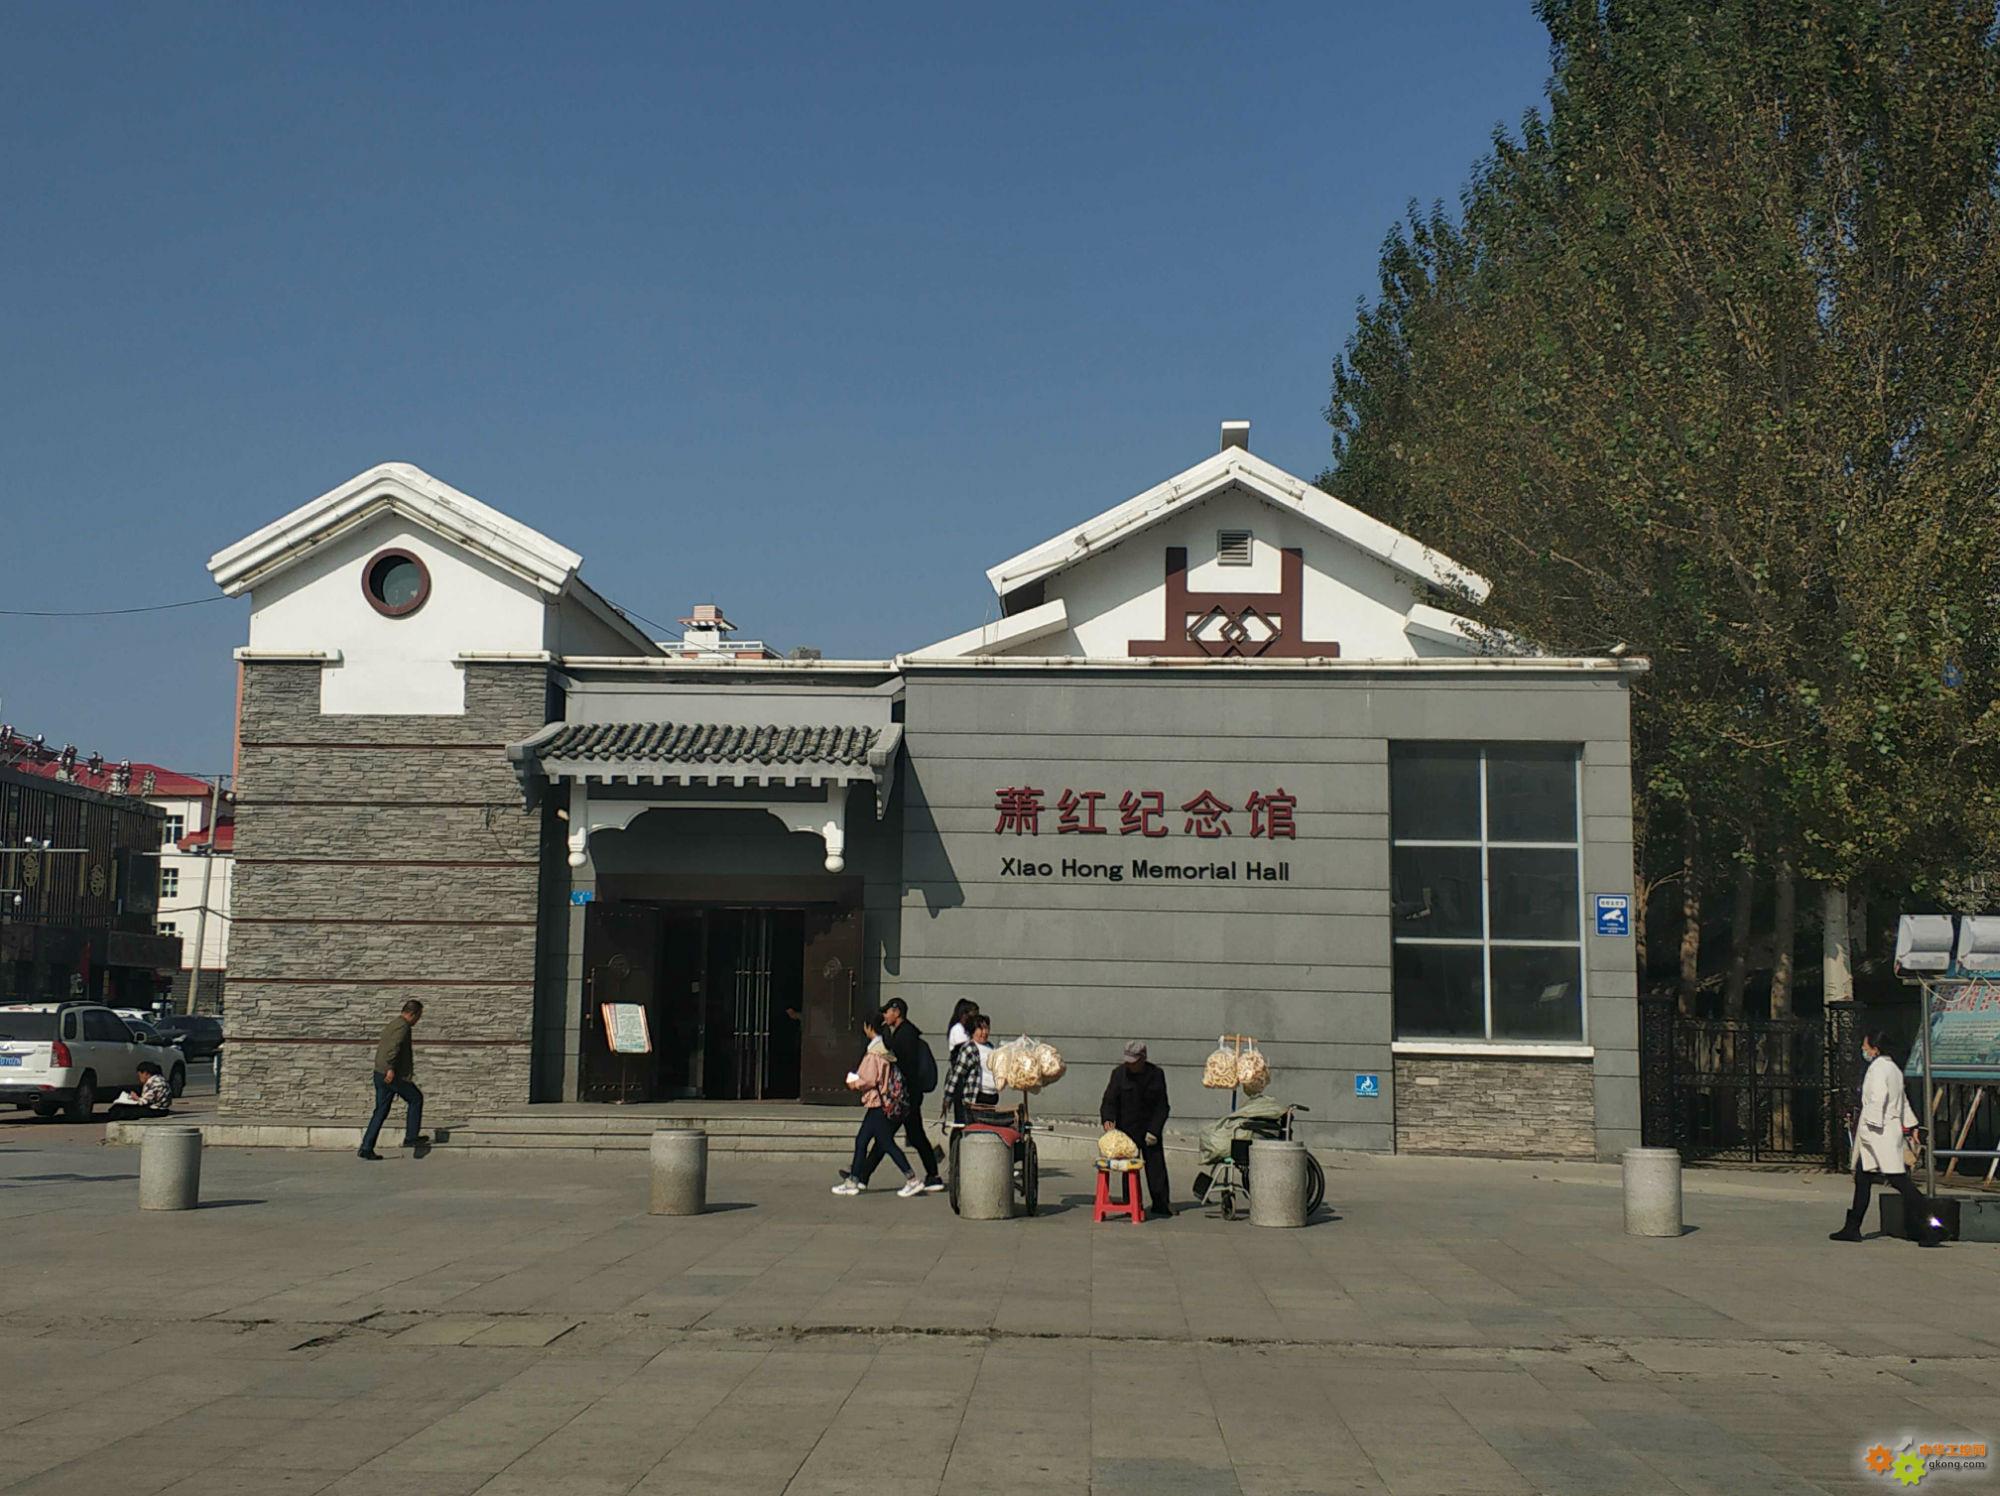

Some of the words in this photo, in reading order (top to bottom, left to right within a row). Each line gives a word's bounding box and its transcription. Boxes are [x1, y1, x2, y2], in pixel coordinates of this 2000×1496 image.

[995, 786, 1297, 839] 萧红纪念馆
[1001, 857, 1053, 877] Xiao
[1062, 859, 1124, 881] Hong
[1132, 860, 1236, 880] Memorial
[1247, 862, 1290, 881] Hall
